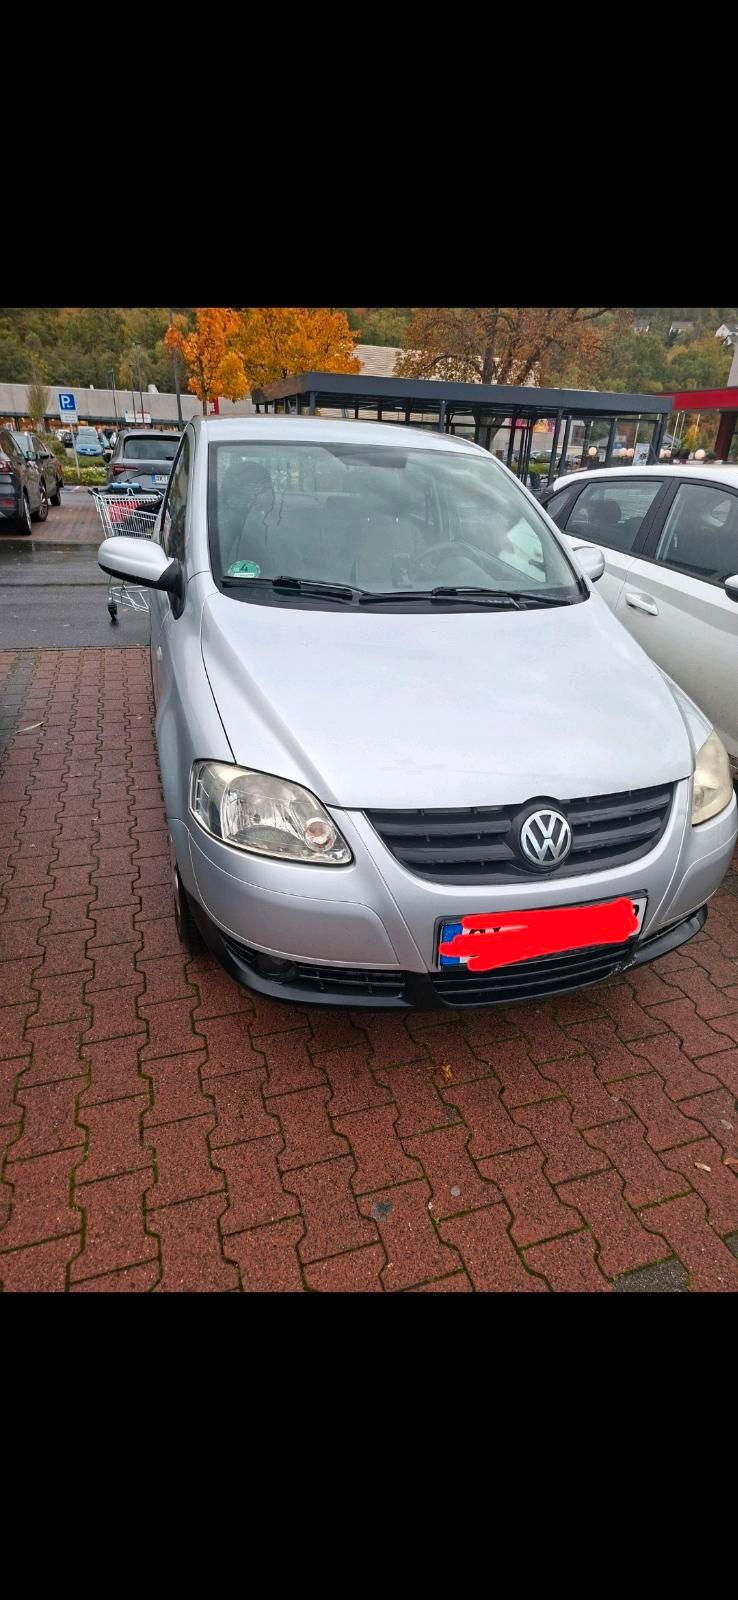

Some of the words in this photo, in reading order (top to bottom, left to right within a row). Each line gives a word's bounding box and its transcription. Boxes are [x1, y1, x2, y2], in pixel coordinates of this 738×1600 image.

[61, 395, 70, 408] P
[241, 563, 248, 572] 4
[522, 810, 571, 865] VW
